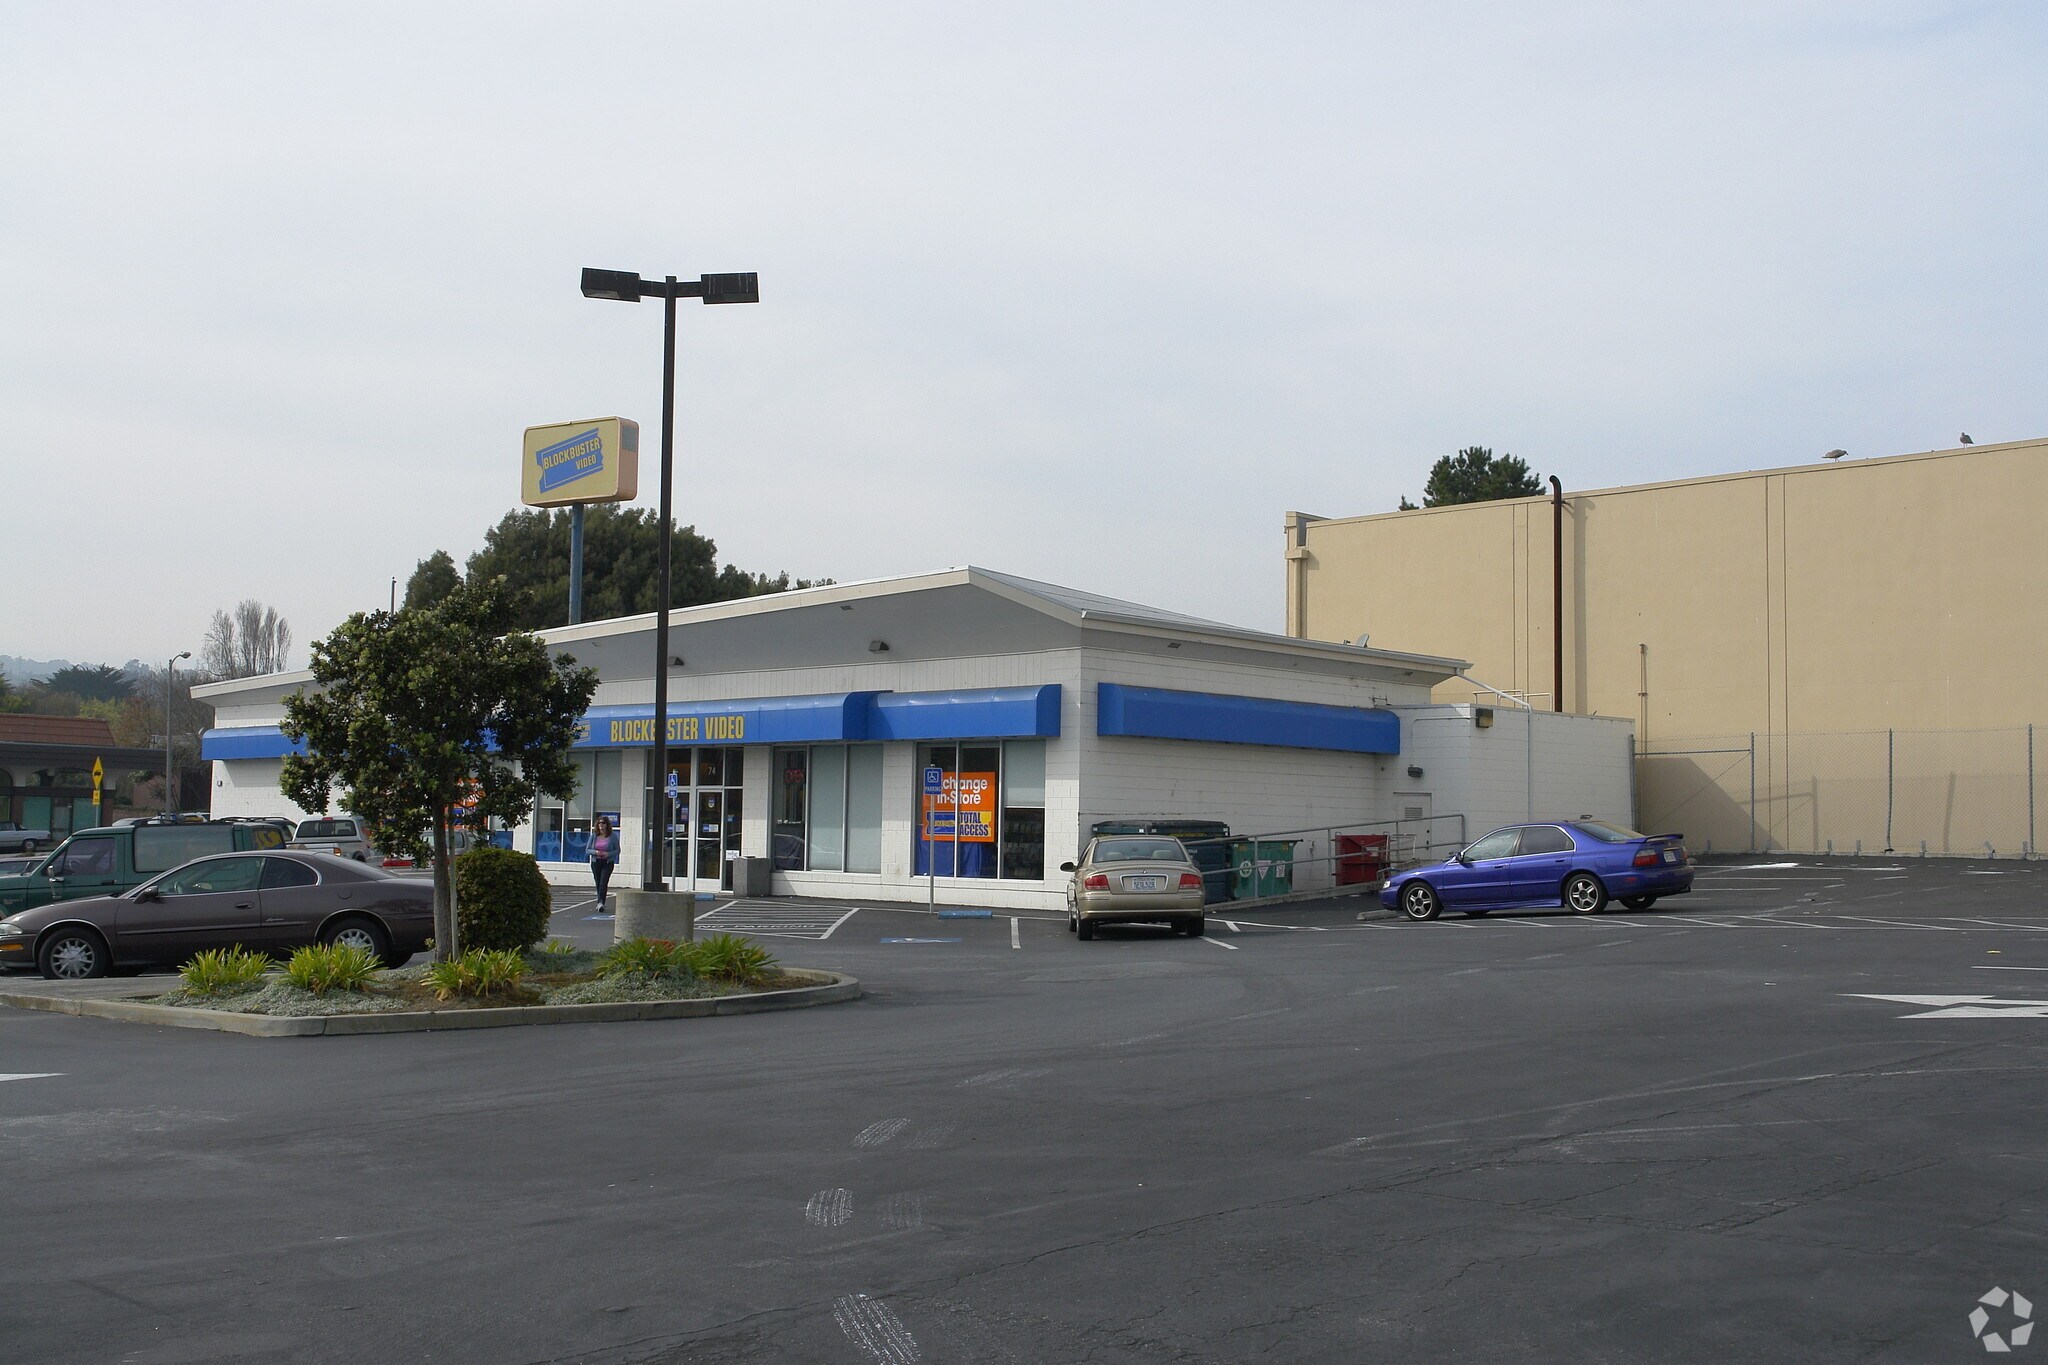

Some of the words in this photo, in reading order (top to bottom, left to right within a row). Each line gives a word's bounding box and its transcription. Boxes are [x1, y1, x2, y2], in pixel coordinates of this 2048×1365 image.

[542, 437, 600, 470] BLOCKBUSTER
[575, 455, 597, 470] VIDEO
[610, 717, 699, 742] BLOCKBSTER
[704, 715, 744, 740] VIDEO
[941, 776, 988, 794] change
[960, 812, 981, 824] TOTAL
[960, 824, 989, 836] ACCESS
